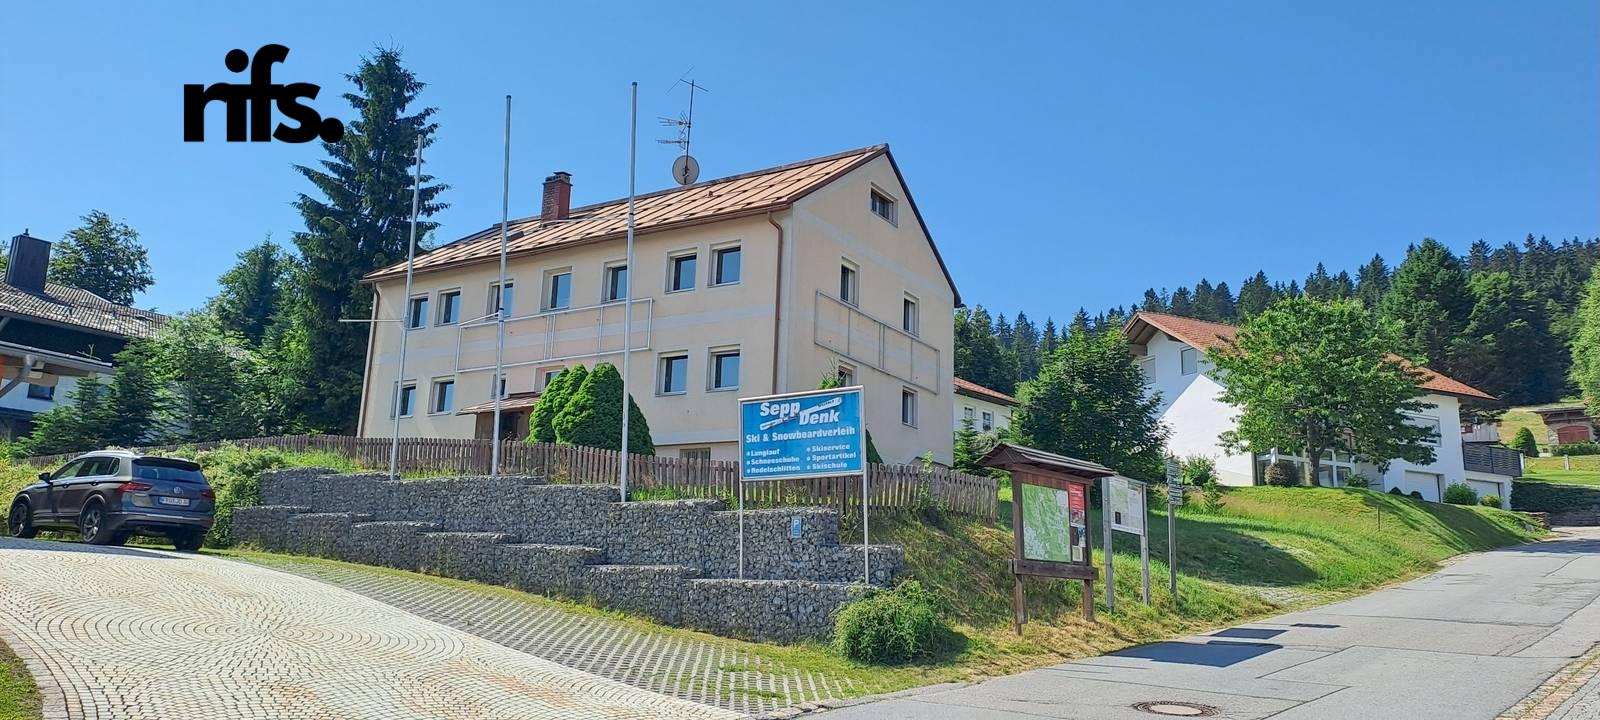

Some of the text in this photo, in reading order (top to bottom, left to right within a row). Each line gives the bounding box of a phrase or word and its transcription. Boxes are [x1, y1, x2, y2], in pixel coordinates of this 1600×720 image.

[760, 401, 800, 418] Sepp
[799, 409, 840, 426] Denk
[746, 426, 855, 443] Ski & Snowboardverleih
[750, 448, 780, 457] Langlauf
[811, 443, 850, 453] Skiservice
[751, 455, 800, 465] Schneeschuhe
[811, 451, 857, 462] Sportartikel
[751, 464, 801, 474] Rodelschlitten
[812, 461, 848, 470] Skischule
[794, 519, 800, 528] P
